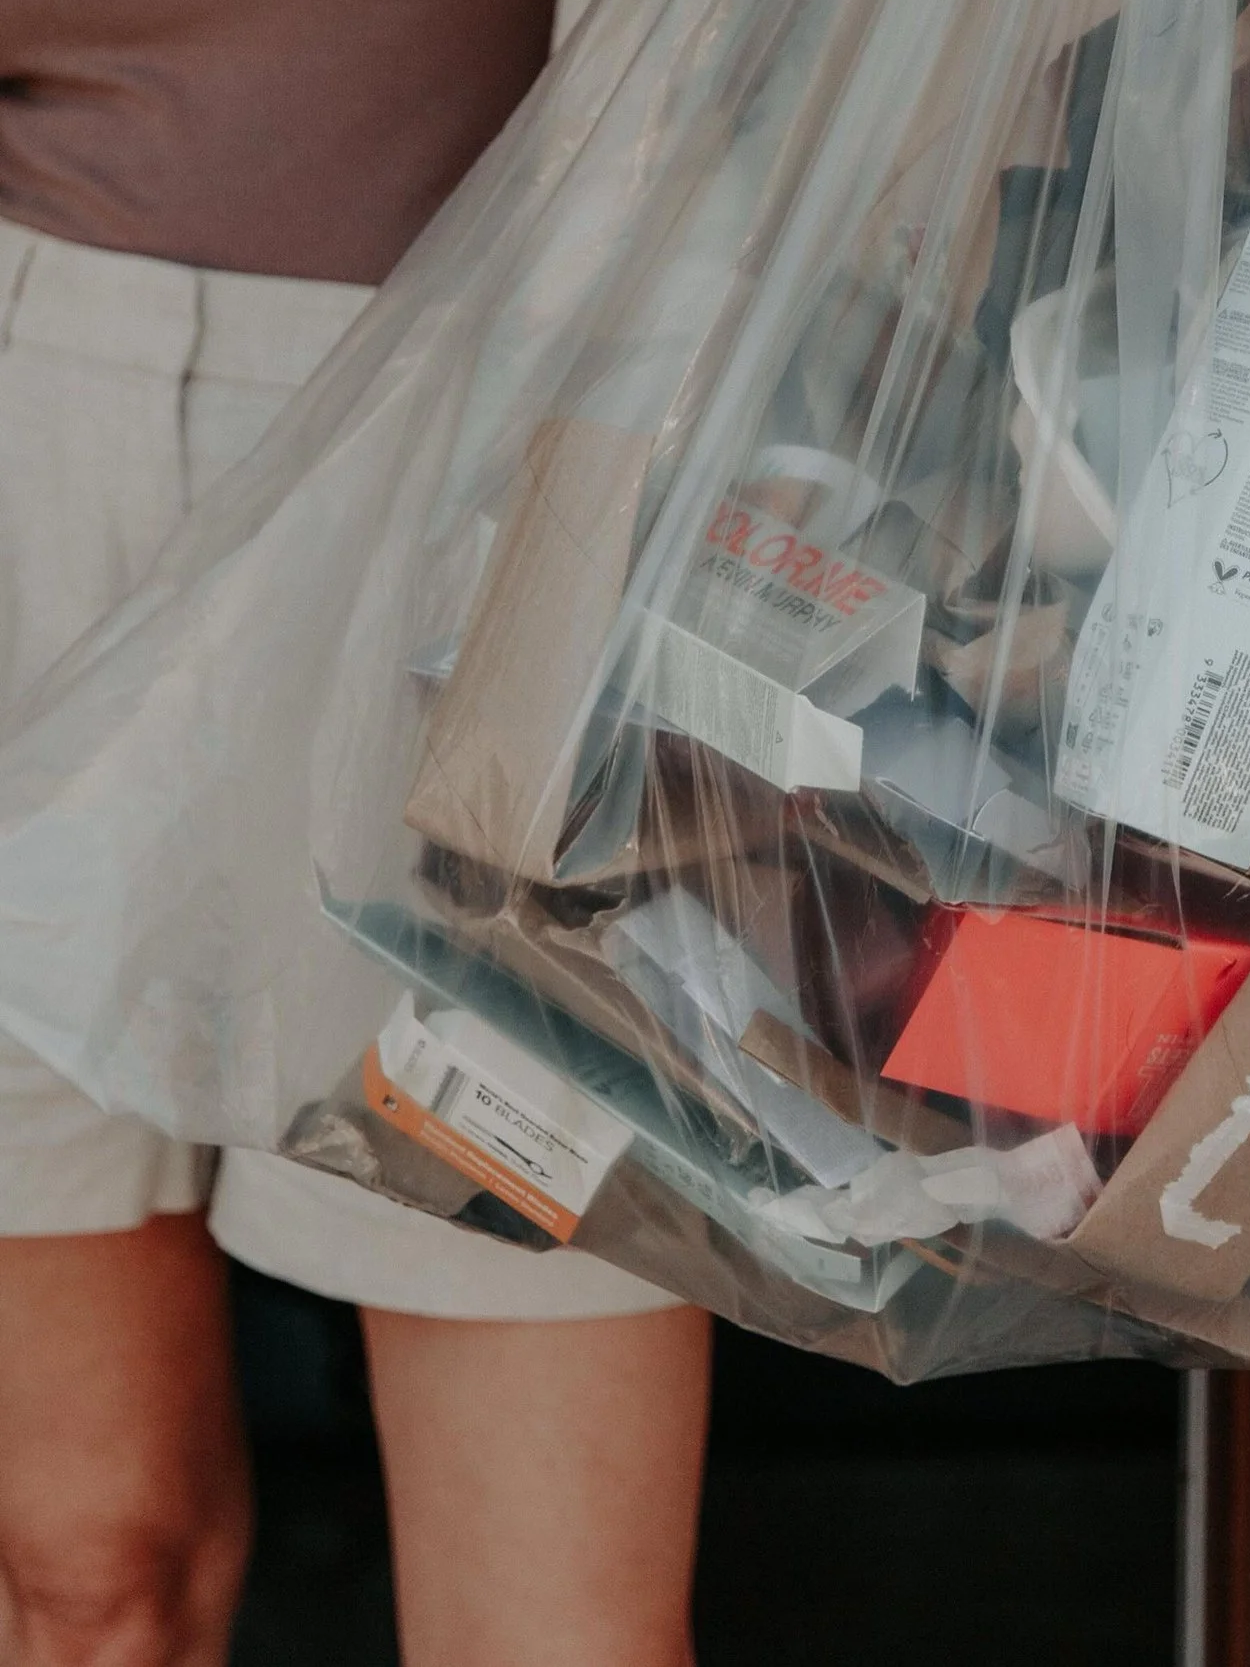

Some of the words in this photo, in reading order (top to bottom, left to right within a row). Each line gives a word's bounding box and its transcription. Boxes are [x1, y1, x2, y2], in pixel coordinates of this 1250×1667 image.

[1202, 656, 1214, 667] 9
[1183, 674, 1208, 724] 333478
[473, 1089, 493, 1107] 10
[493, 1103, 556, 1153] BLADES
